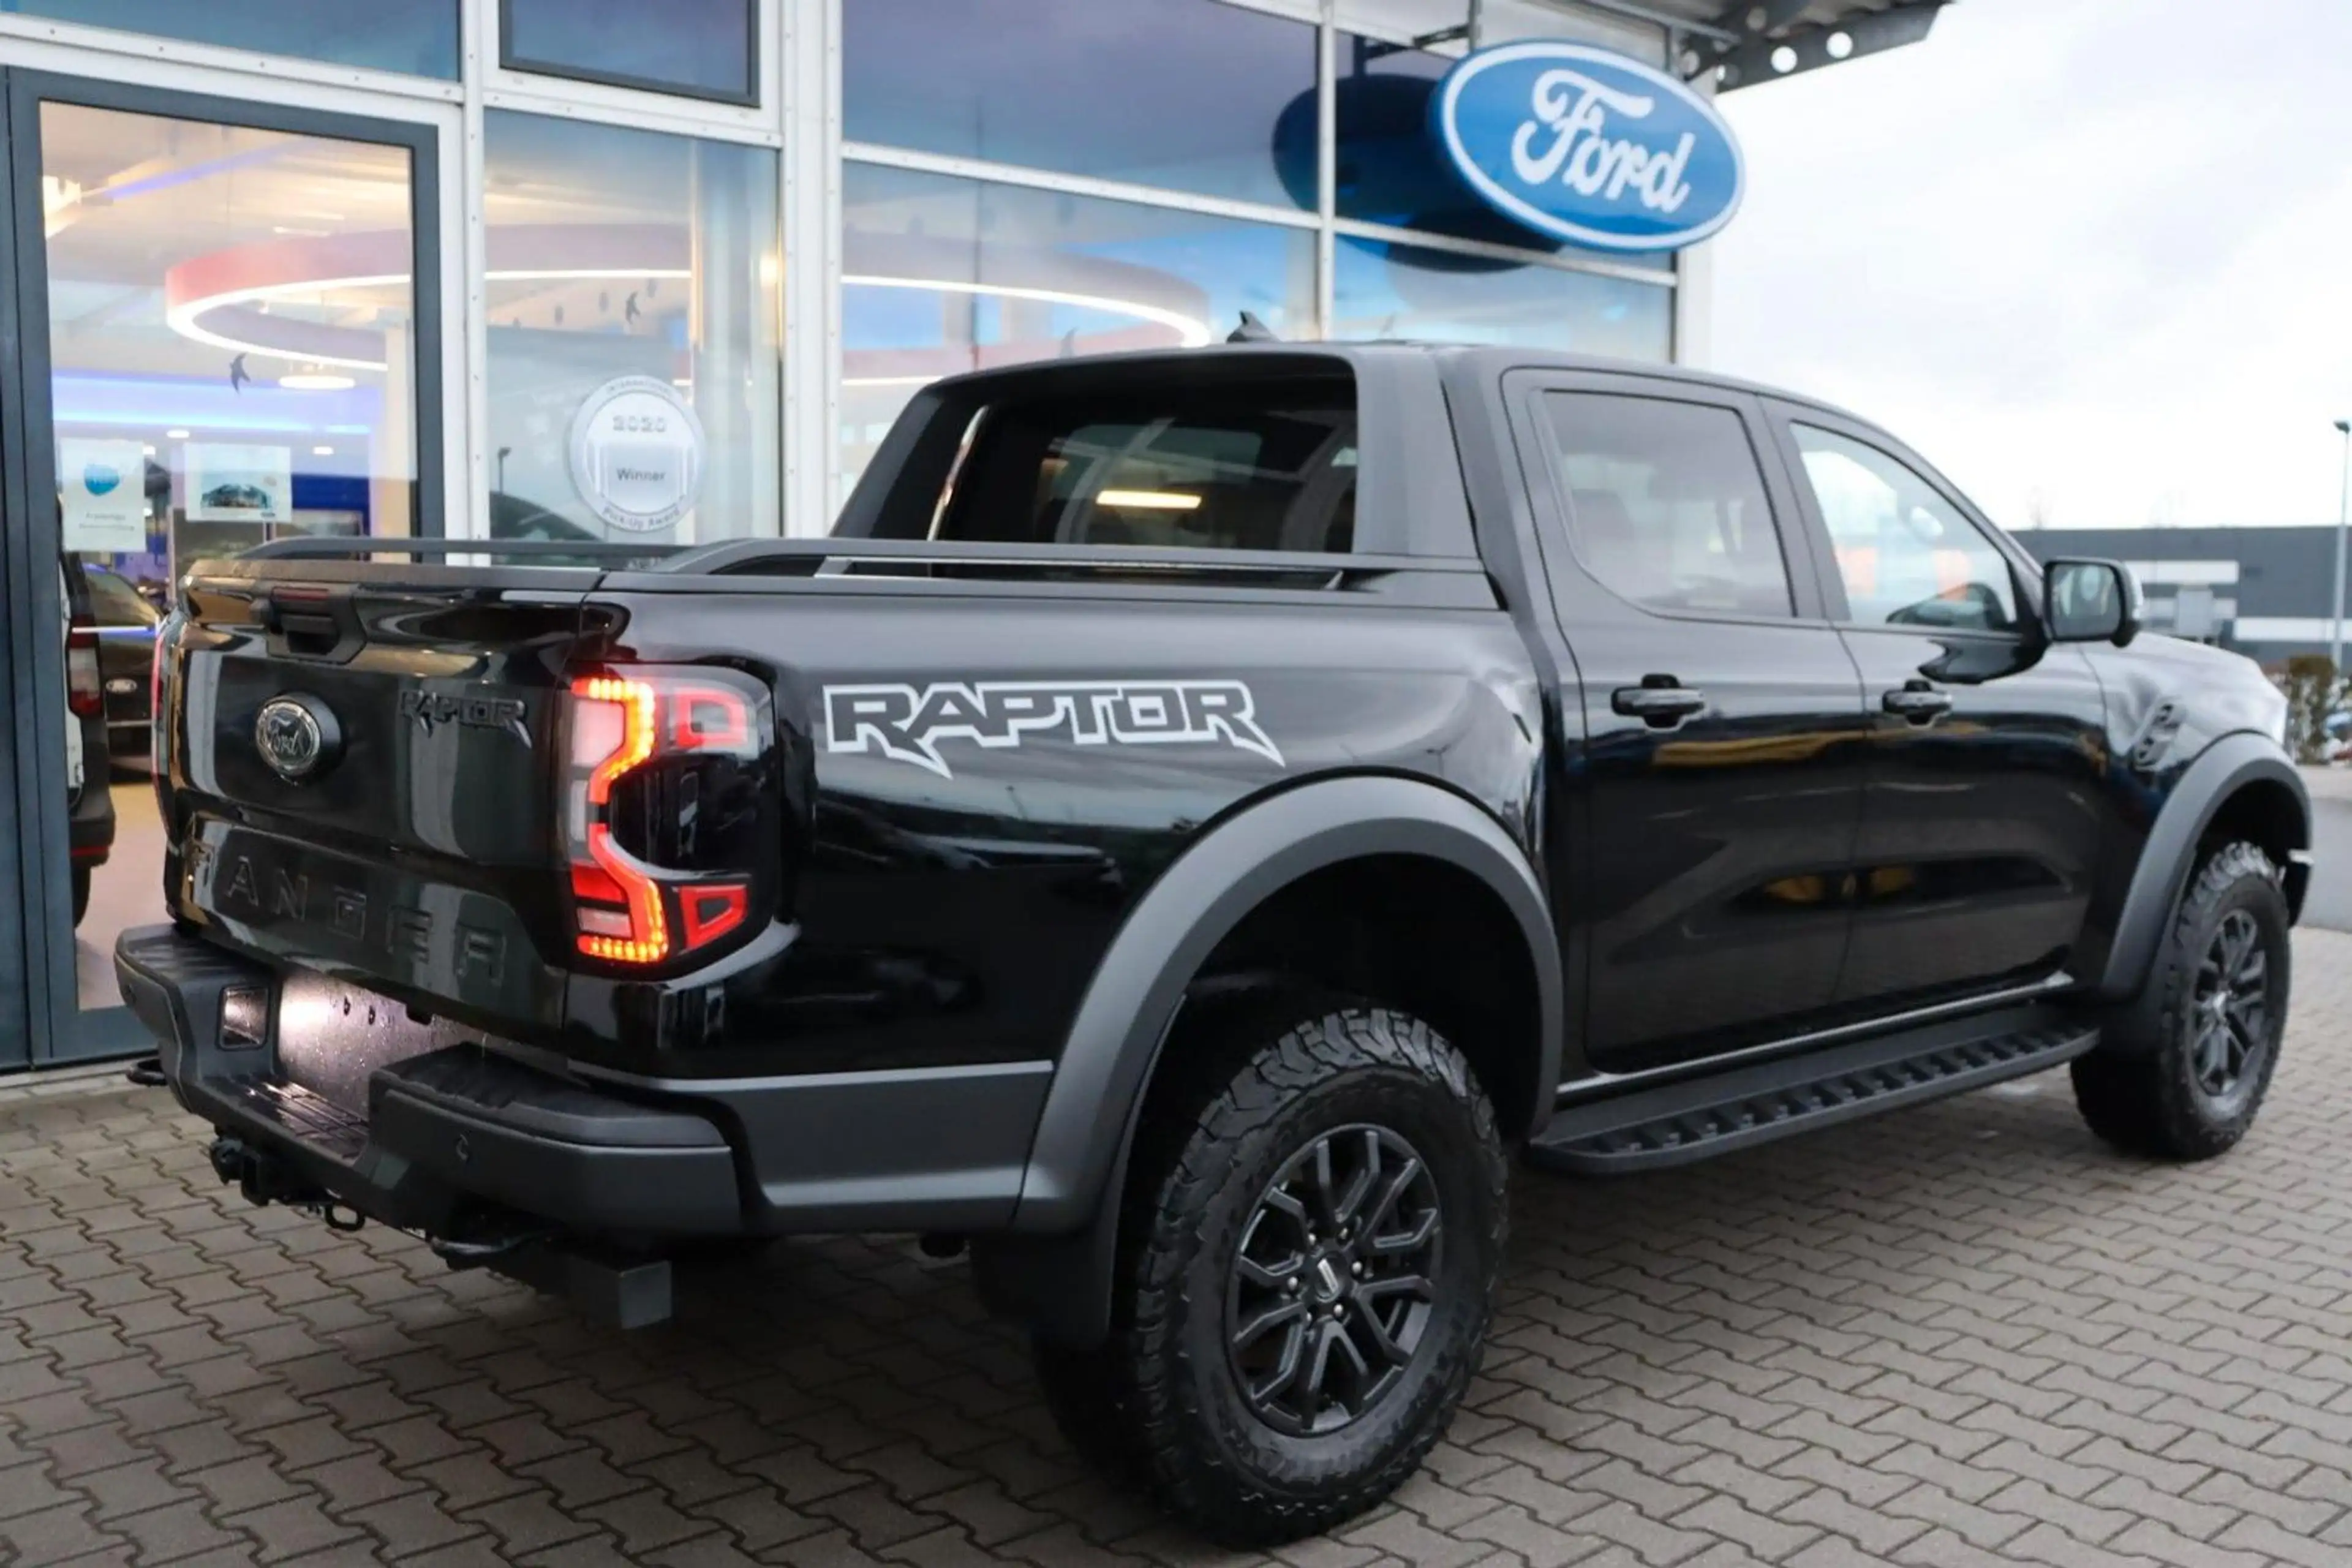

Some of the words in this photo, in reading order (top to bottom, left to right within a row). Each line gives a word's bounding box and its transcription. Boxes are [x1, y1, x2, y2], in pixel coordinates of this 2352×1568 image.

[1511, 69, 1696, 213] Ford
[612, 415, 666, 432] 2020
[616, 467, 666, 481] Winner
[401, 690, 532, 749] RAPTOR
[823, 680, 1286, 780] RAPTOR
